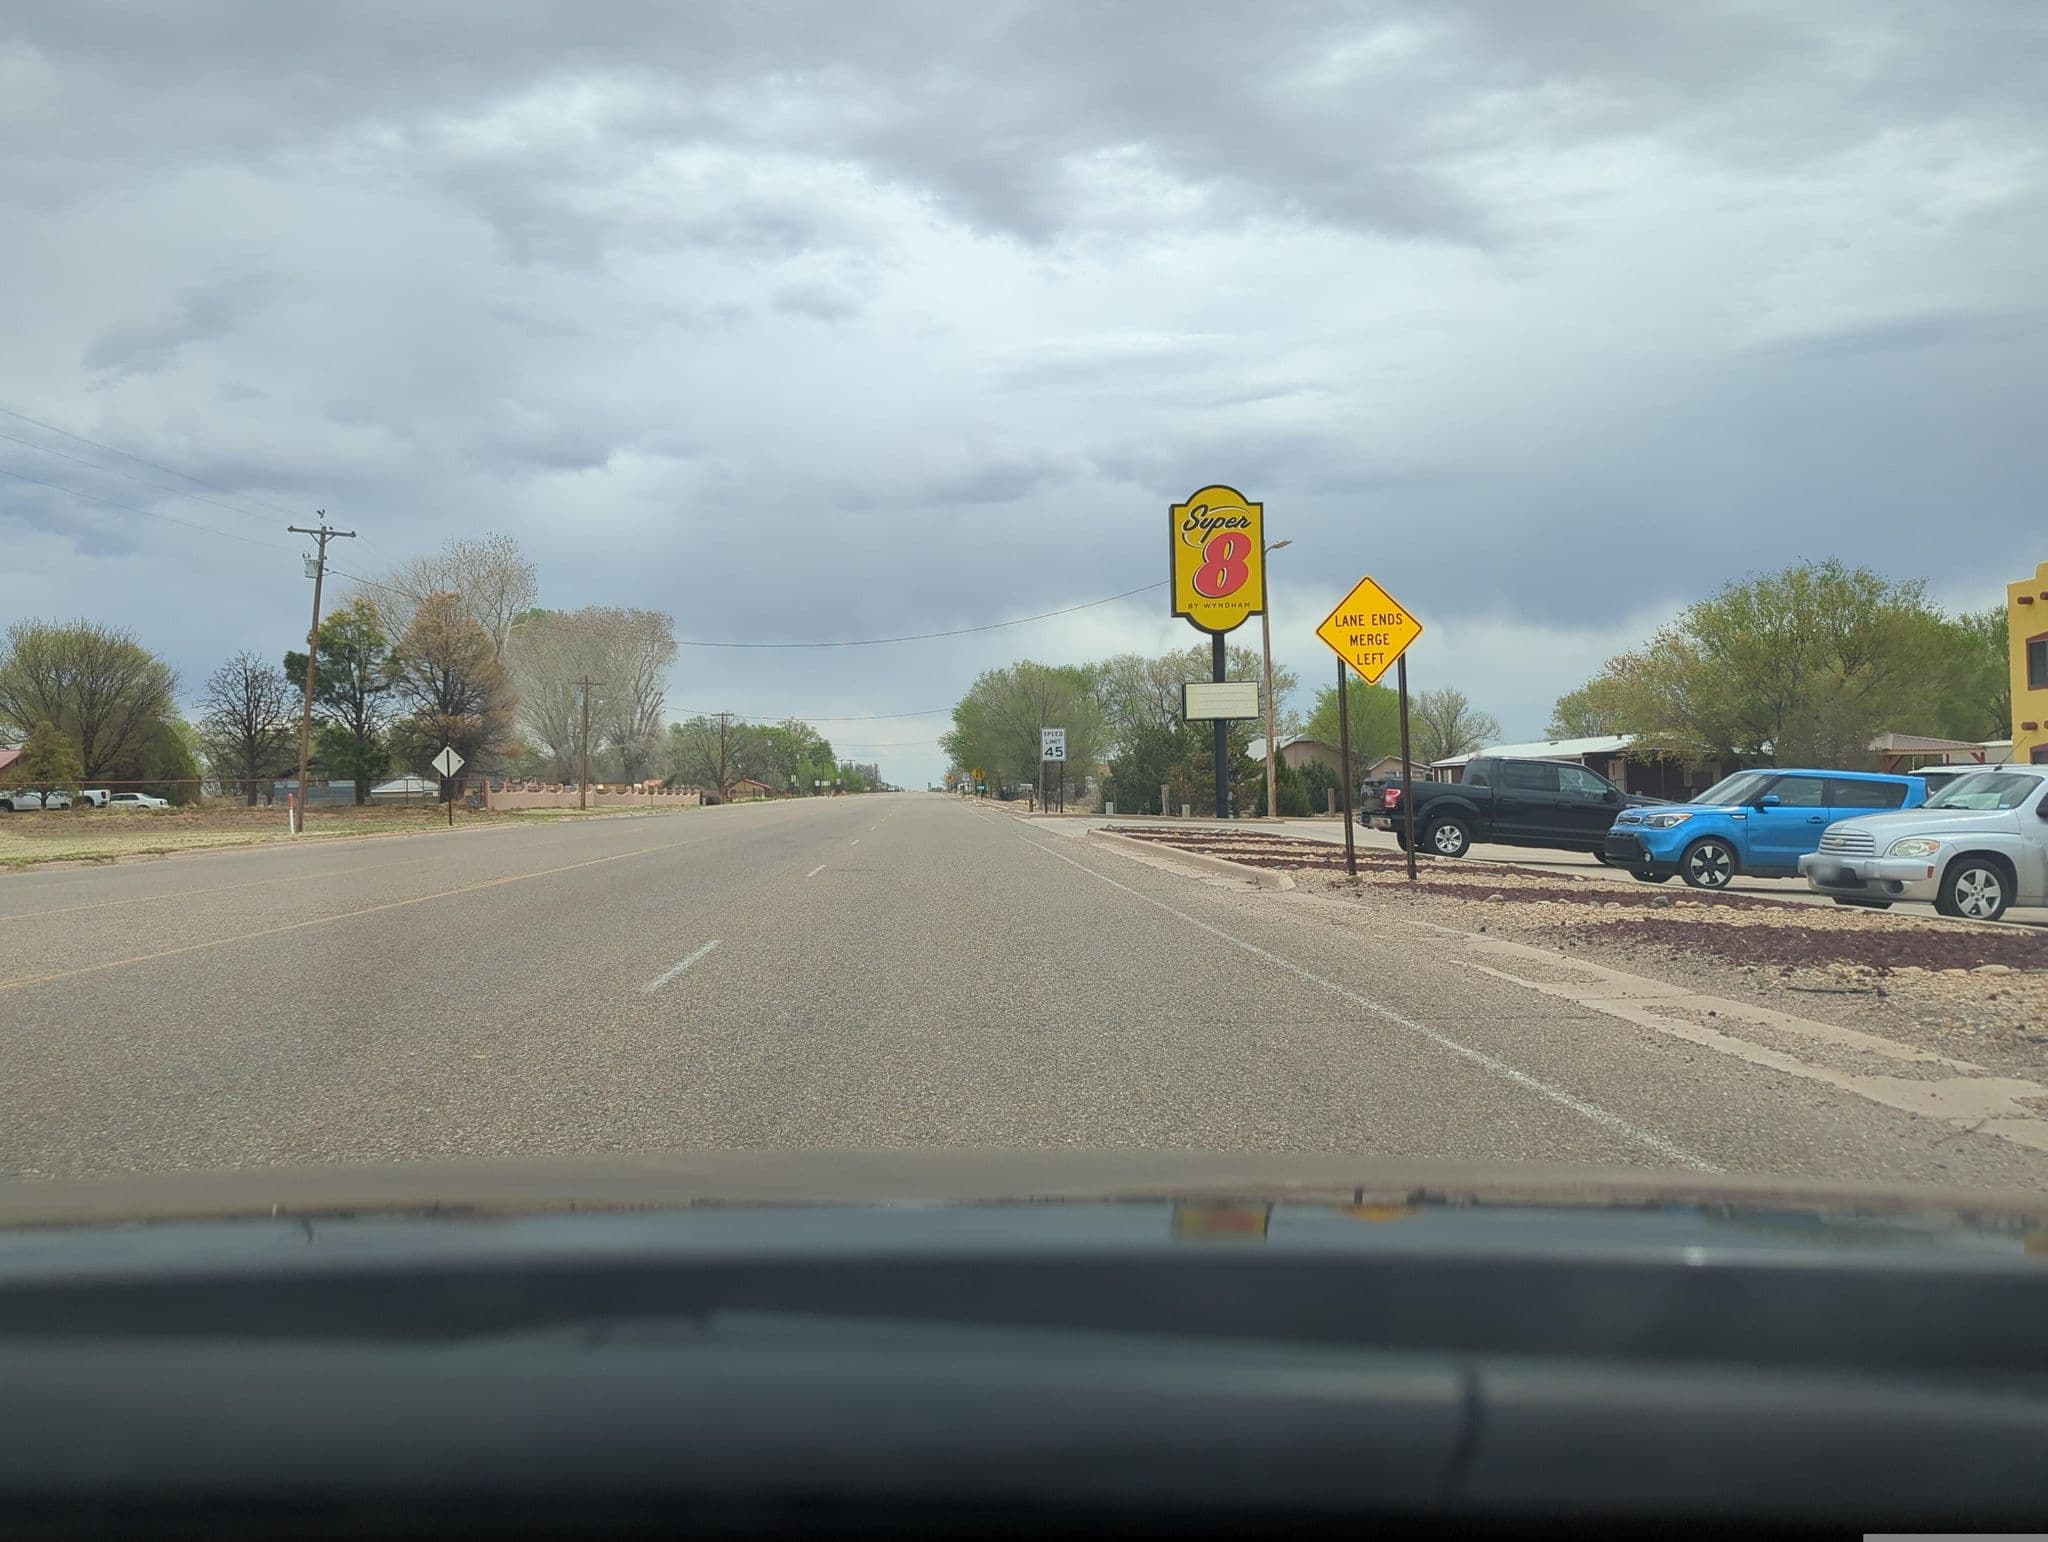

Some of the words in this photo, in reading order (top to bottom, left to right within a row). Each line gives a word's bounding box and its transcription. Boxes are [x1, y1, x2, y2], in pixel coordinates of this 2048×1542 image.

[1182, 504, 1251, 546] Super
[1193, 532, 1252, 598] 8
[1203, 601, 1250, 609] WYNDHAM
[1335, 614, 1365, 627] LANE
[1371, 613, 1403, 626] ENDS
[1349, 633, 1390, 646] MERGE
[1357, 652, 1385, 665] LEFT
[1044, 746, 1064, 757] 45
